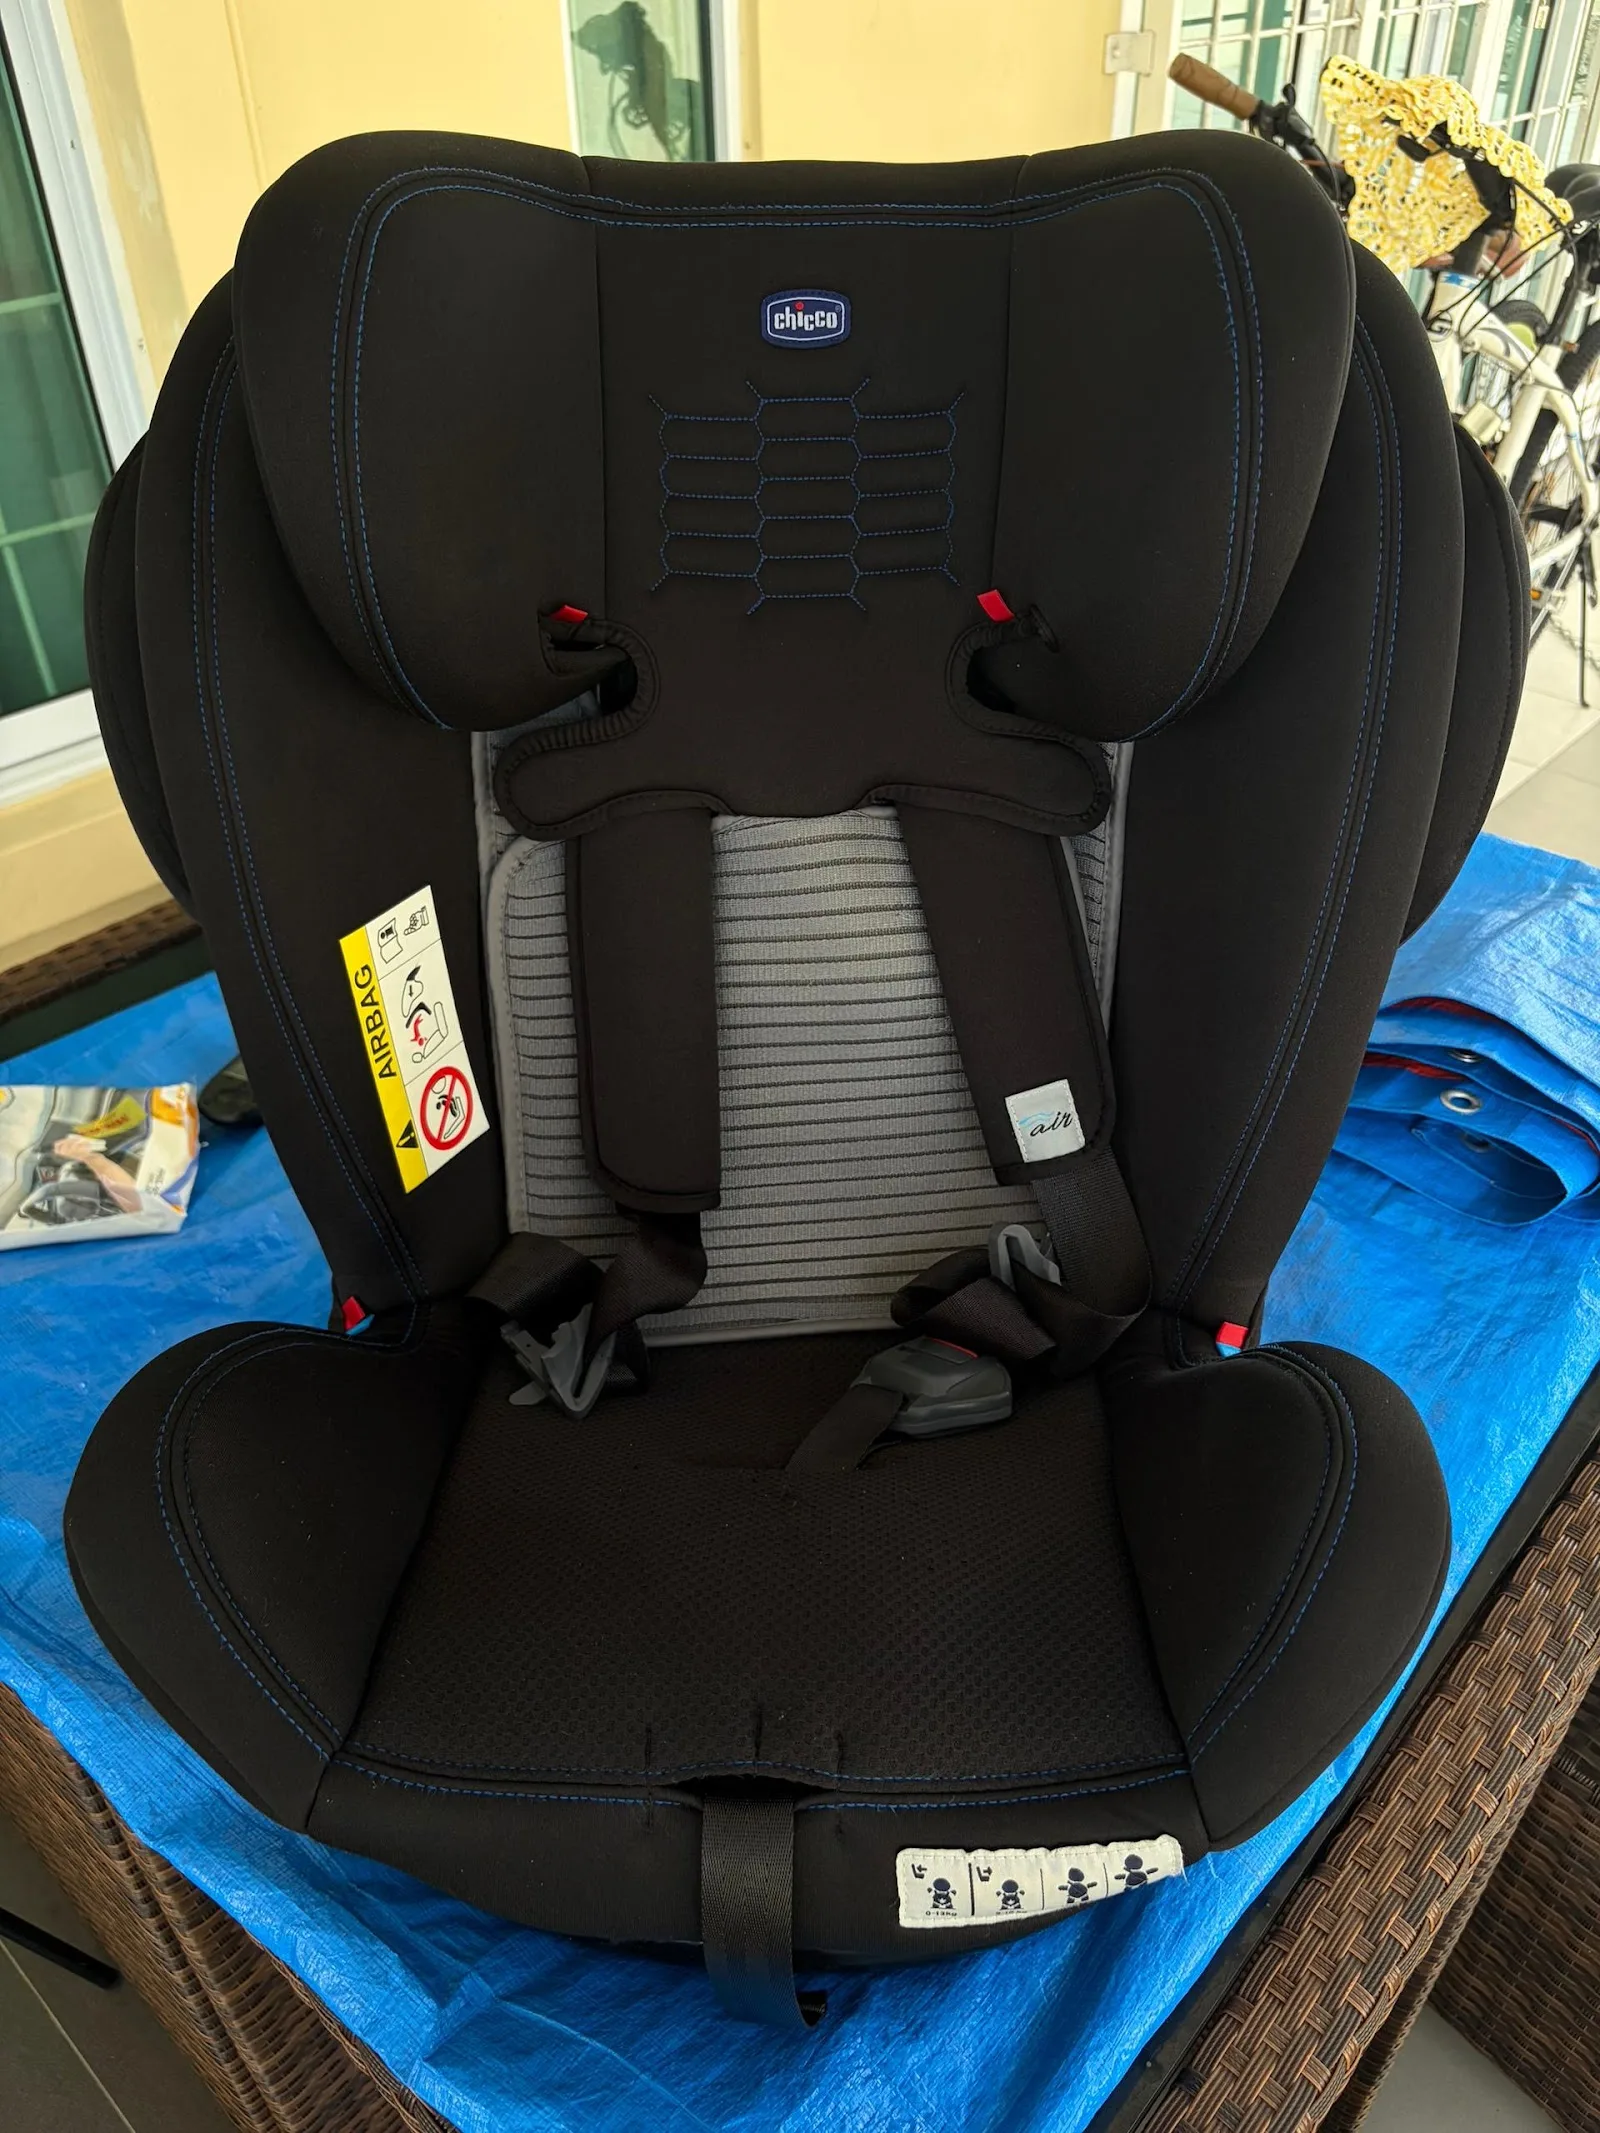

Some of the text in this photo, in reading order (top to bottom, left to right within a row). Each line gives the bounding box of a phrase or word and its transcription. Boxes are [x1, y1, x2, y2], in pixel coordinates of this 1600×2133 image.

[774, 301, 838, 331] chicco
[355, 964, 397, 1079] AIRBAG
[1030, 1111, 1073, 1137] air
